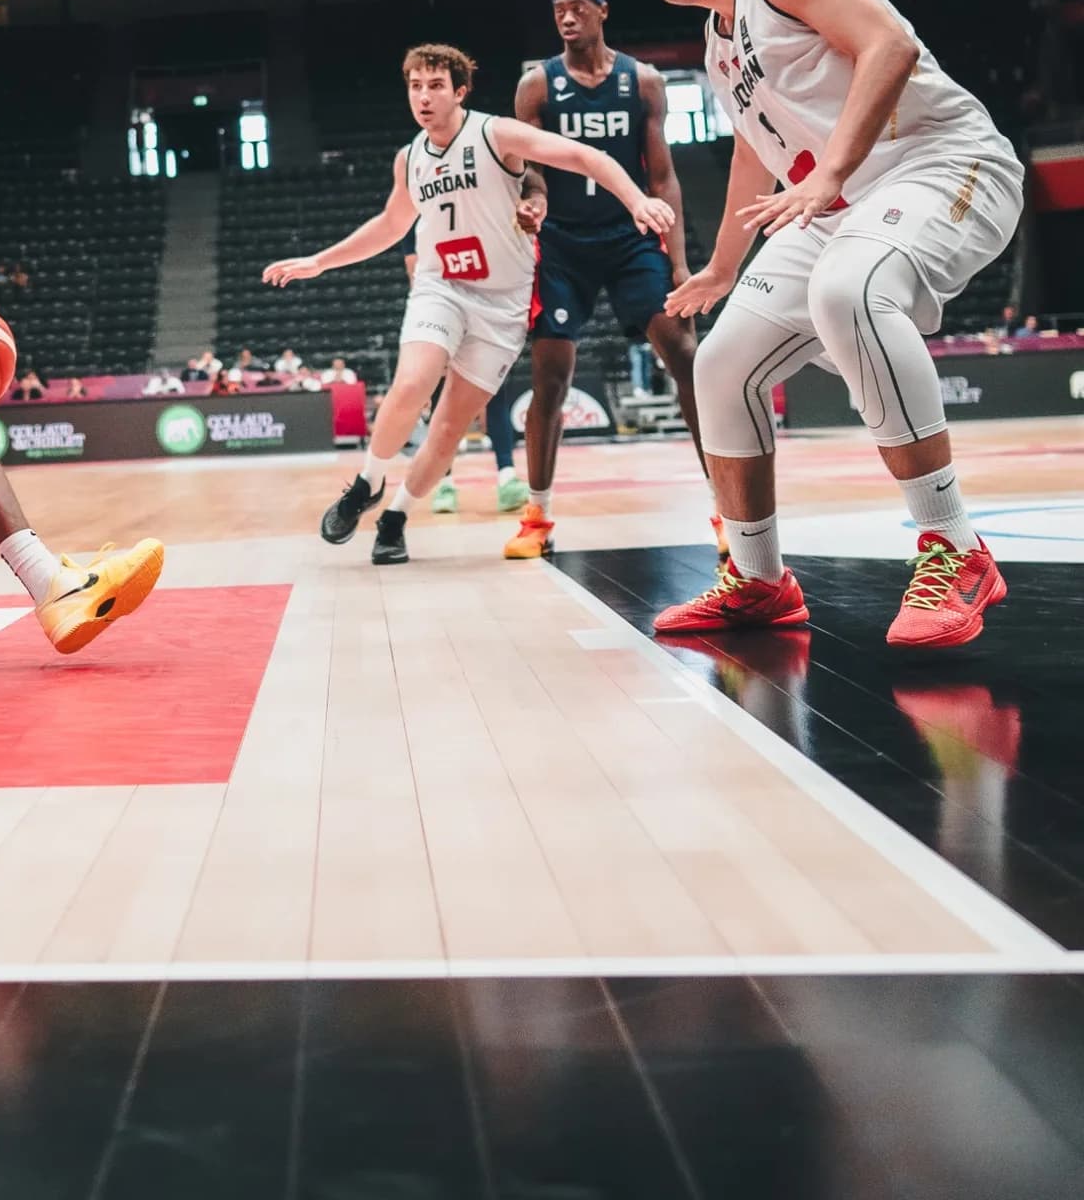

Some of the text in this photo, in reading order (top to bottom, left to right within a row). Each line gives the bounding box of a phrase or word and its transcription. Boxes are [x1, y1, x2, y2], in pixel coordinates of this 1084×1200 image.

[560, 111, 630, 138] USA
[419, 171, 478, 202] JORDAN
[440, 202, 455, 231] 7
[445, 249, 482, 275] CFI
